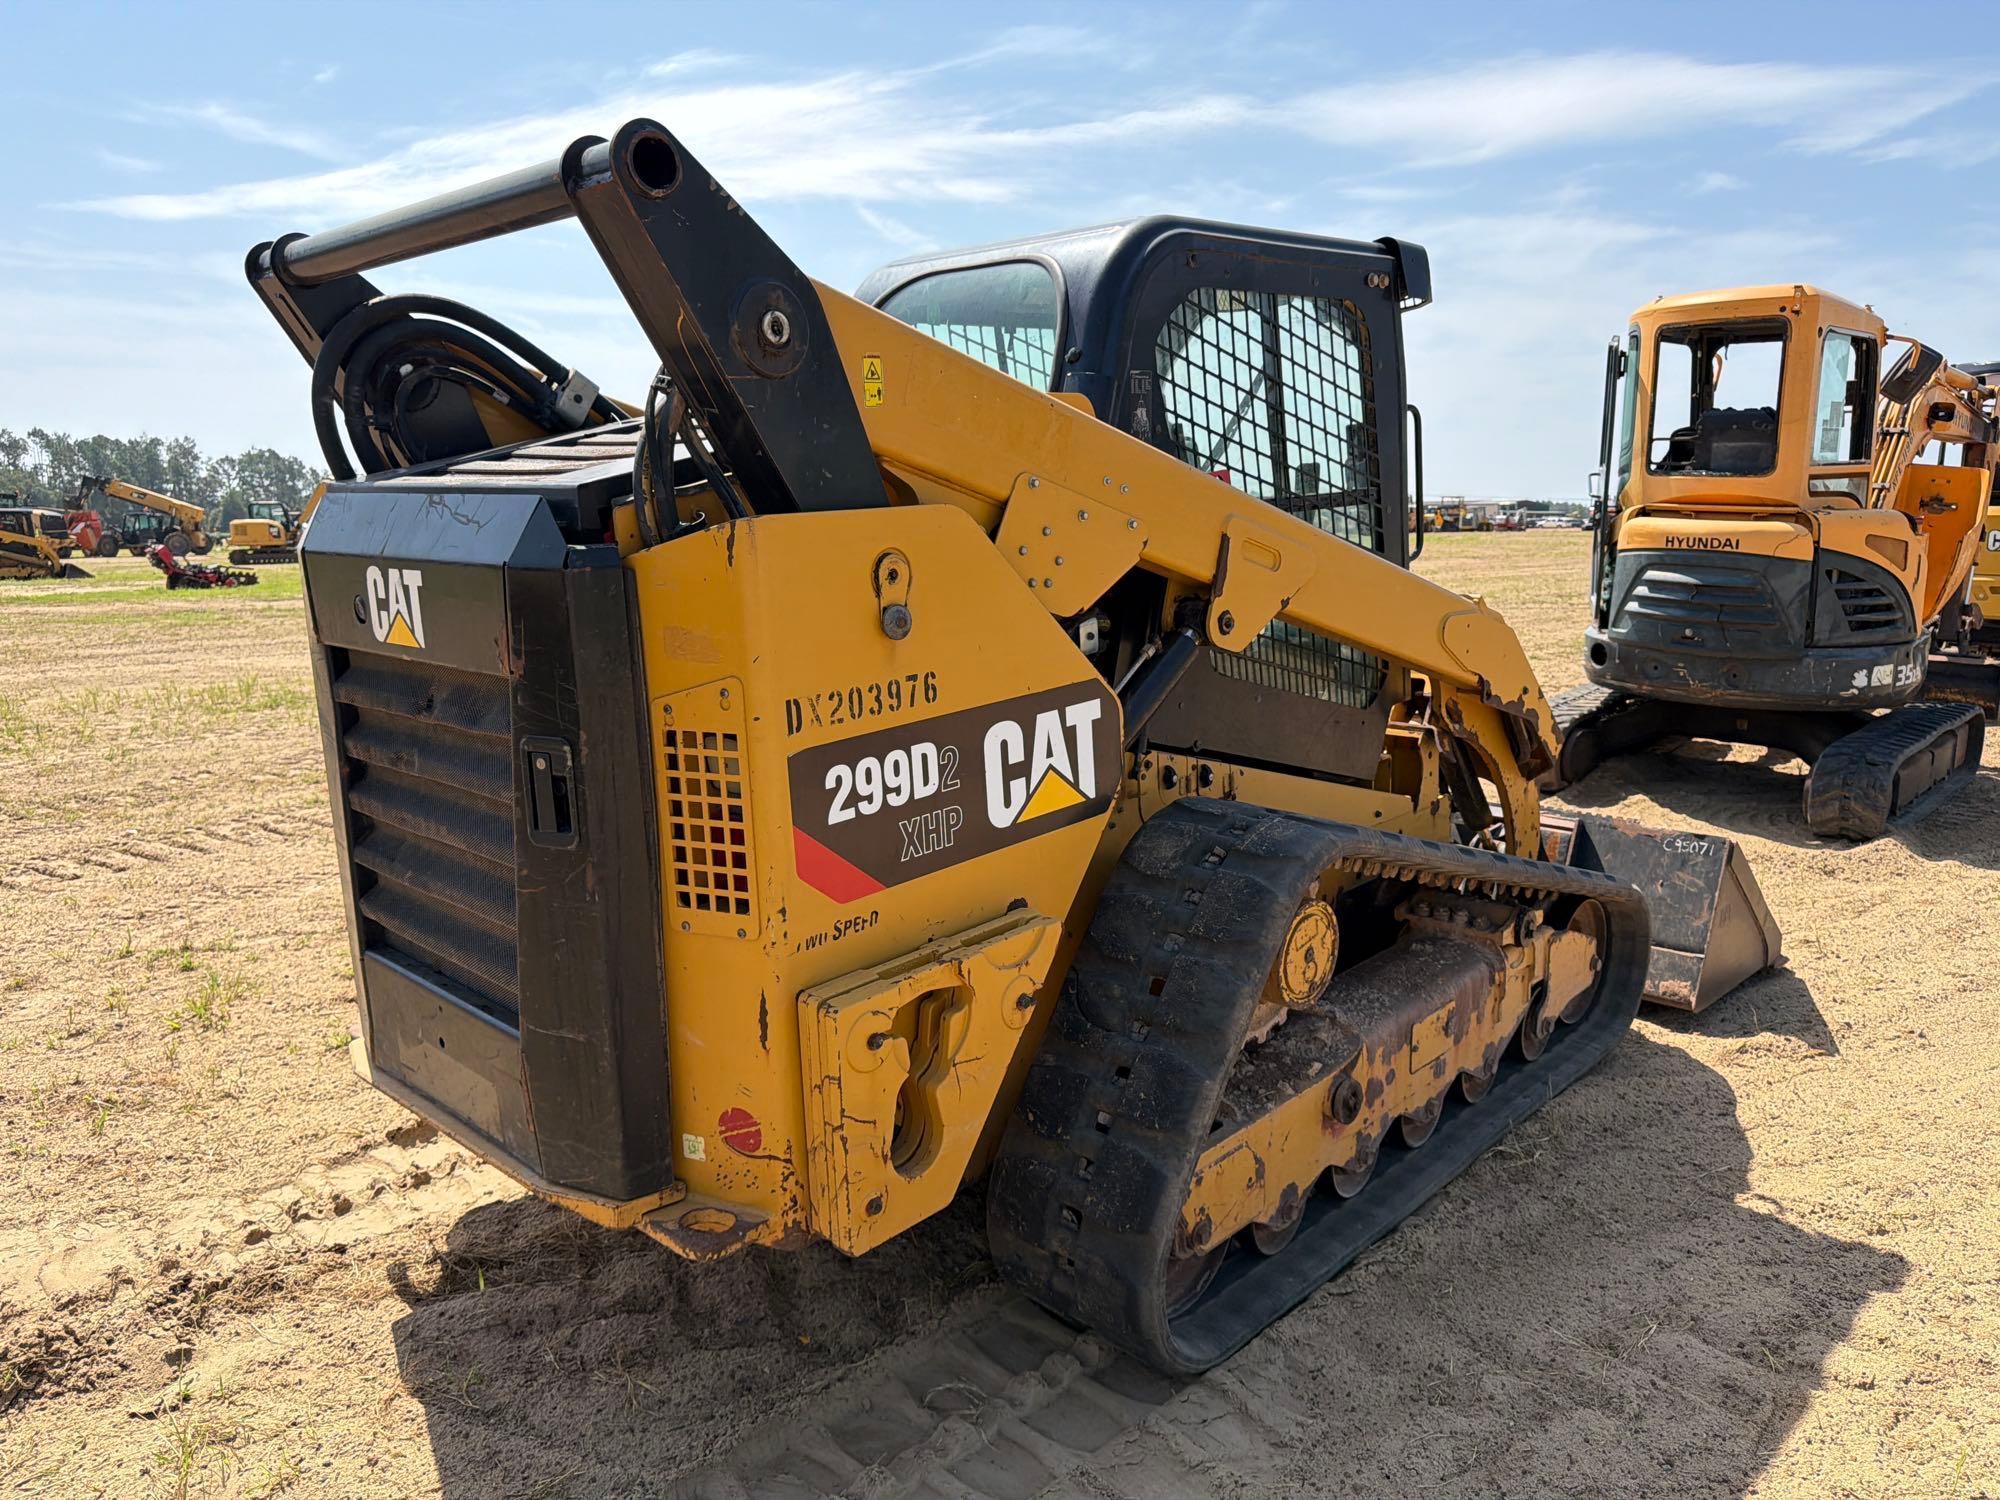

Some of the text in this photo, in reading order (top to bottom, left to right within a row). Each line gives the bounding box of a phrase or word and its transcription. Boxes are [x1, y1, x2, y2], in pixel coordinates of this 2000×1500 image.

[1665, 535, 1740, 550] HYUNDAI
[366, 565, 426, 649] CAT
[785, 670, 938, 738] DX203976
[825, 741, 961, 826] 299D2
[983, 698, 1102, 829] CAT
[898, 804, 964, 863] XHP
